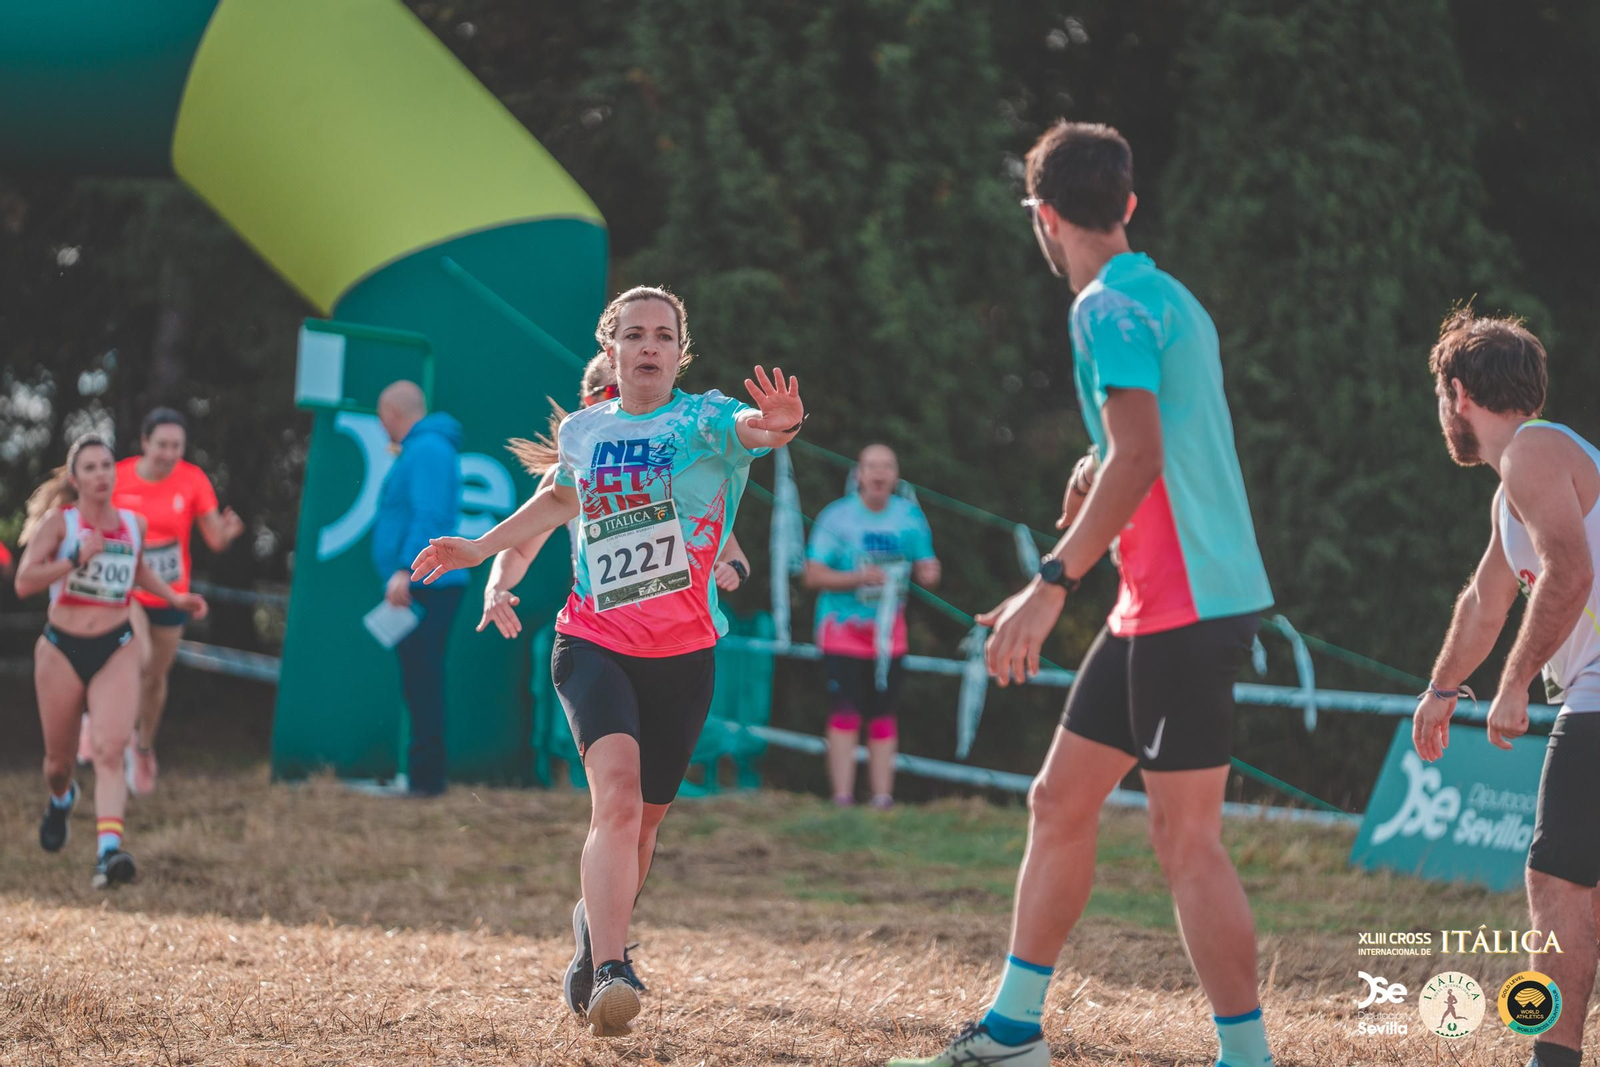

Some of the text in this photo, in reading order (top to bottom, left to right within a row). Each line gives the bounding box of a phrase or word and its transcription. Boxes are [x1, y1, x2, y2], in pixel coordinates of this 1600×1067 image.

[604, 511, 651, 531] ITÁLICA
[597, 535, 675, 585] 2227
[1453, 808, 1534, 853] Sevilla
